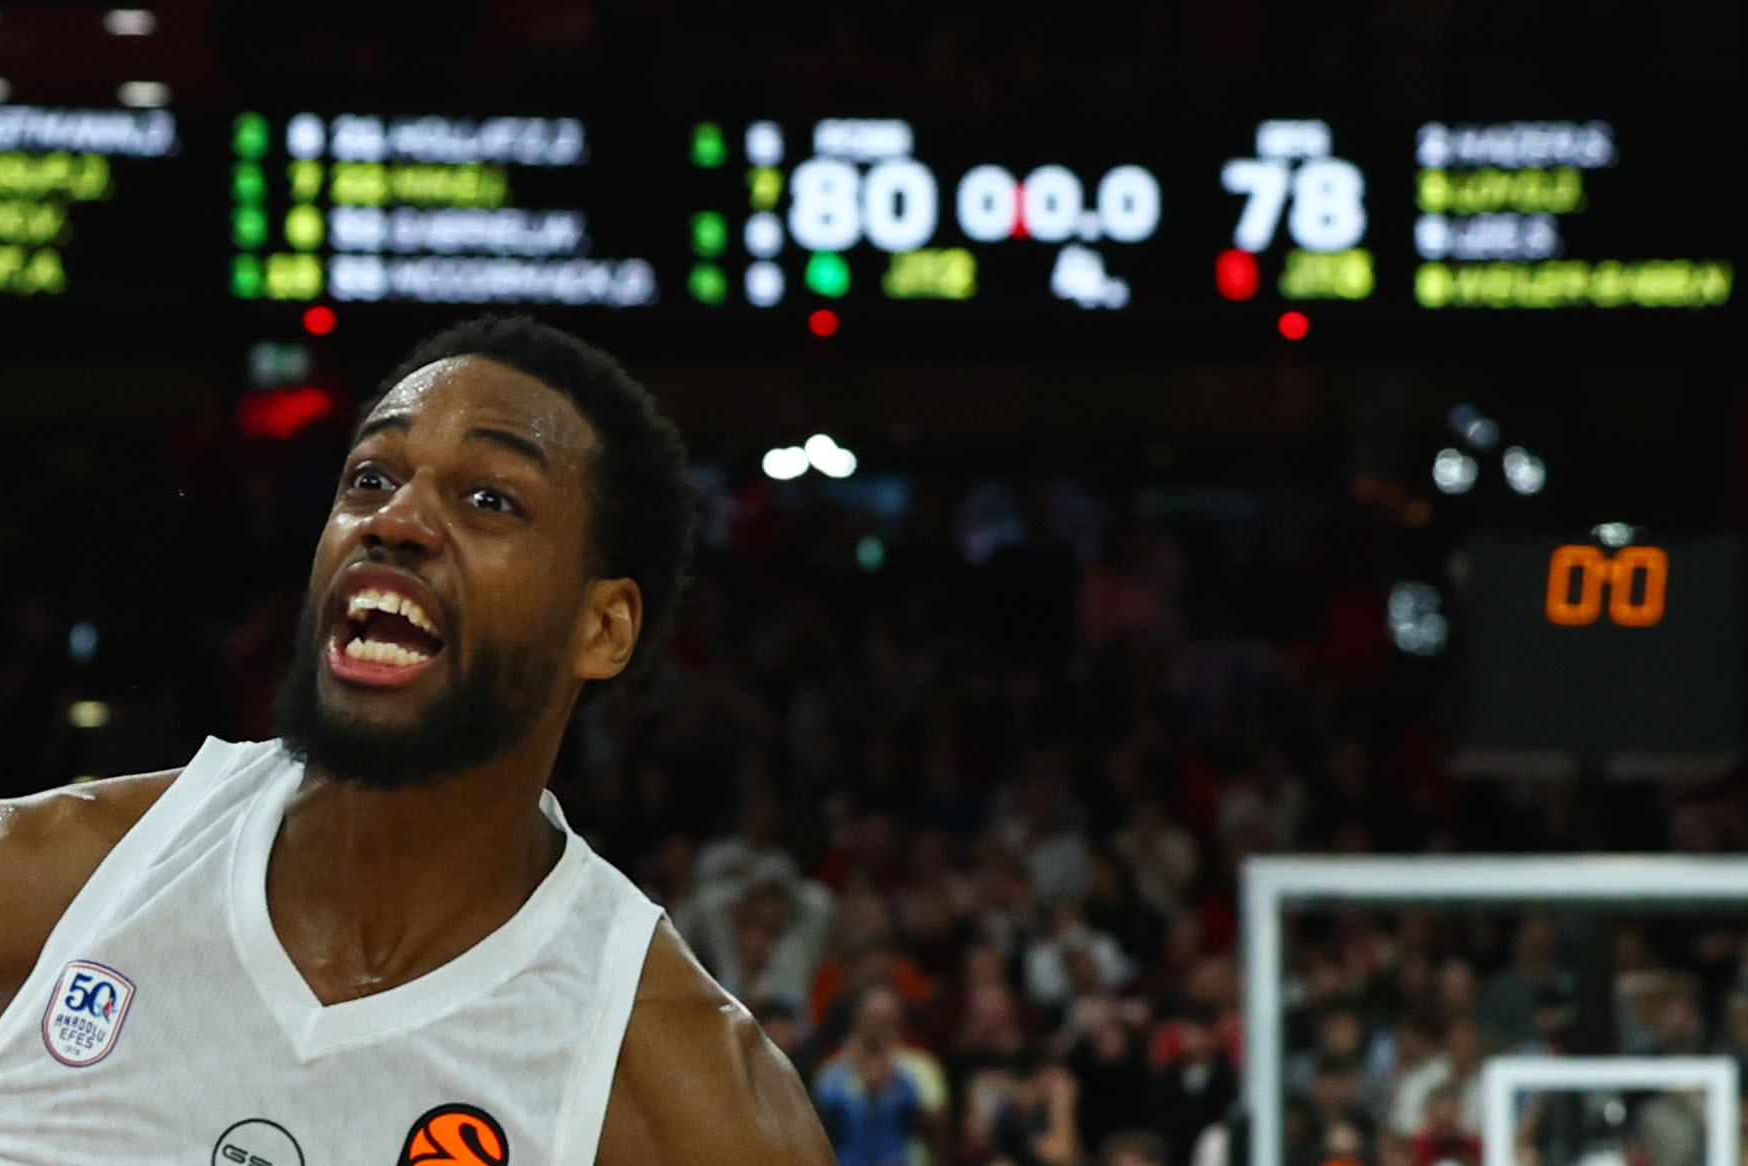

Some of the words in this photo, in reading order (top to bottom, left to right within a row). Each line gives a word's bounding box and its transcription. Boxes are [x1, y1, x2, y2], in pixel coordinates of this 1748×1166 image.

[789, 155, 940, 253] 80
[1220, 156, 1368, 253] 78
[1545, 544, 1669, 627] 00
[54, 1013, 106, 1043] ANADOLU
[64, 971, 117, 1024] 50
[59, 1027, 94, 1050] EFES
